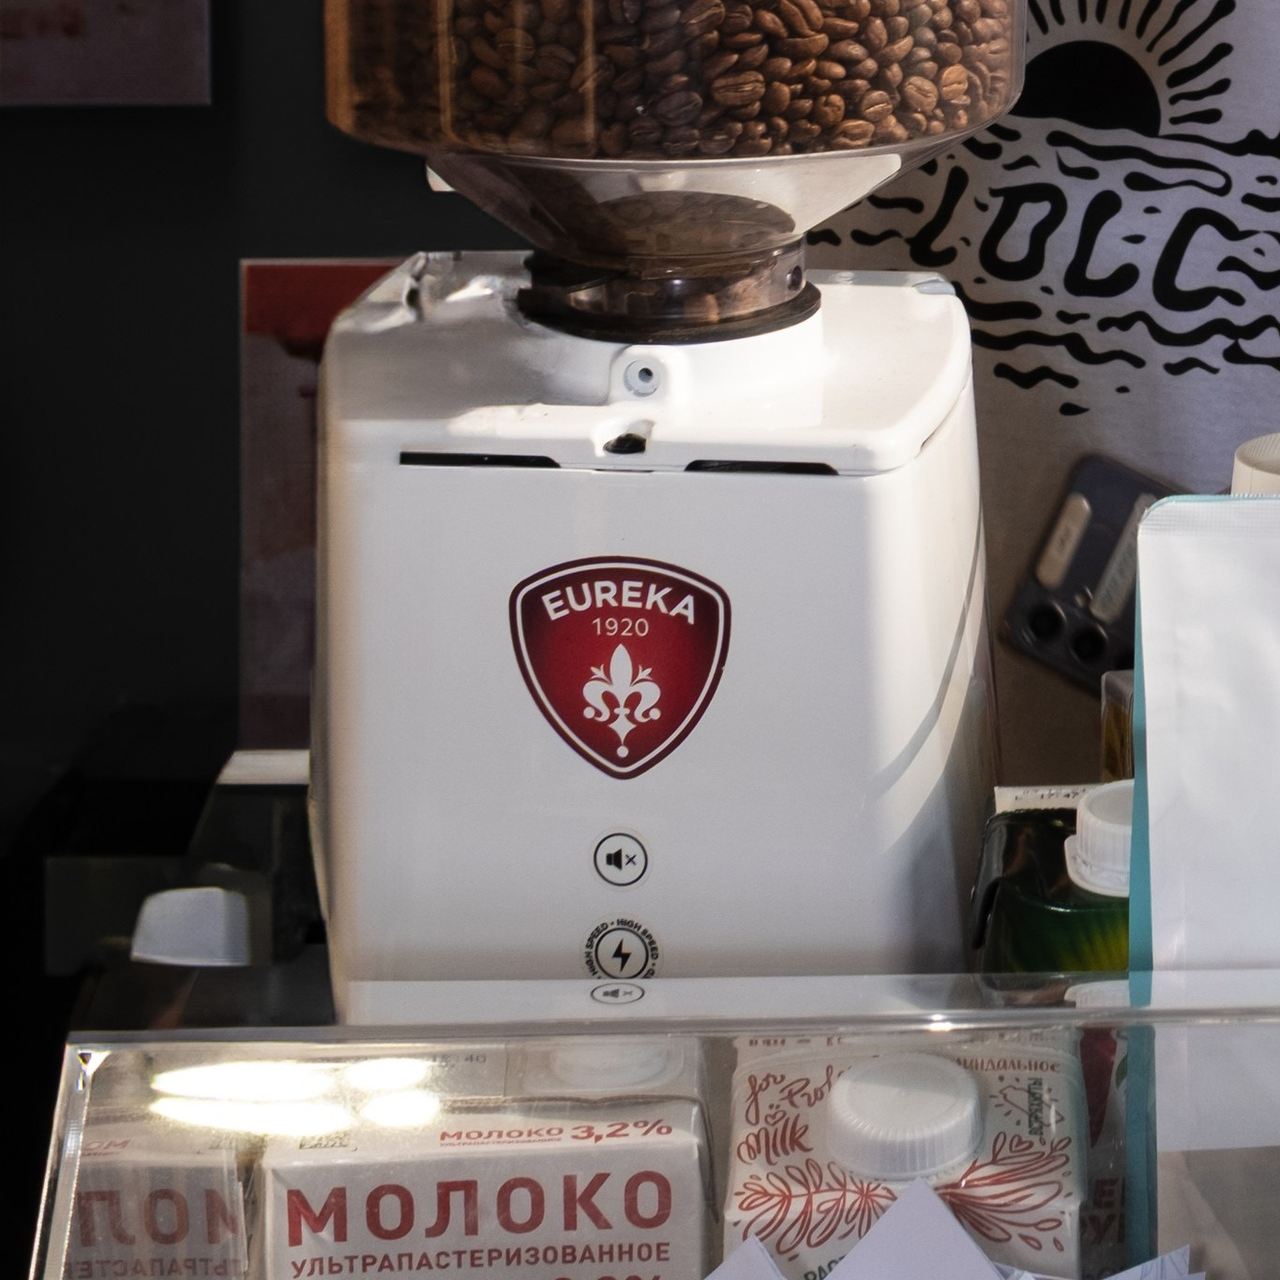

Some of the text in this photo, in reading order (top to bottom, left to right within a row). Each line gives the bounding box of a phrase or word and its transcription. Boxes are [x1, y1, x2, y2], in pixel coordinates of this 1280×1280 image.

[542, 579, 695, 625] EUREKA
[592, 617, 650, 637] 1920
[439, 1119, 673, 1143] МОЛОКО 3,2%
[286, 1170, 672, 1247] МОЛОКО
[291, 1241, 671, 1280] УЛЬТРАПАСТЕРИЗОВАННОЕ
